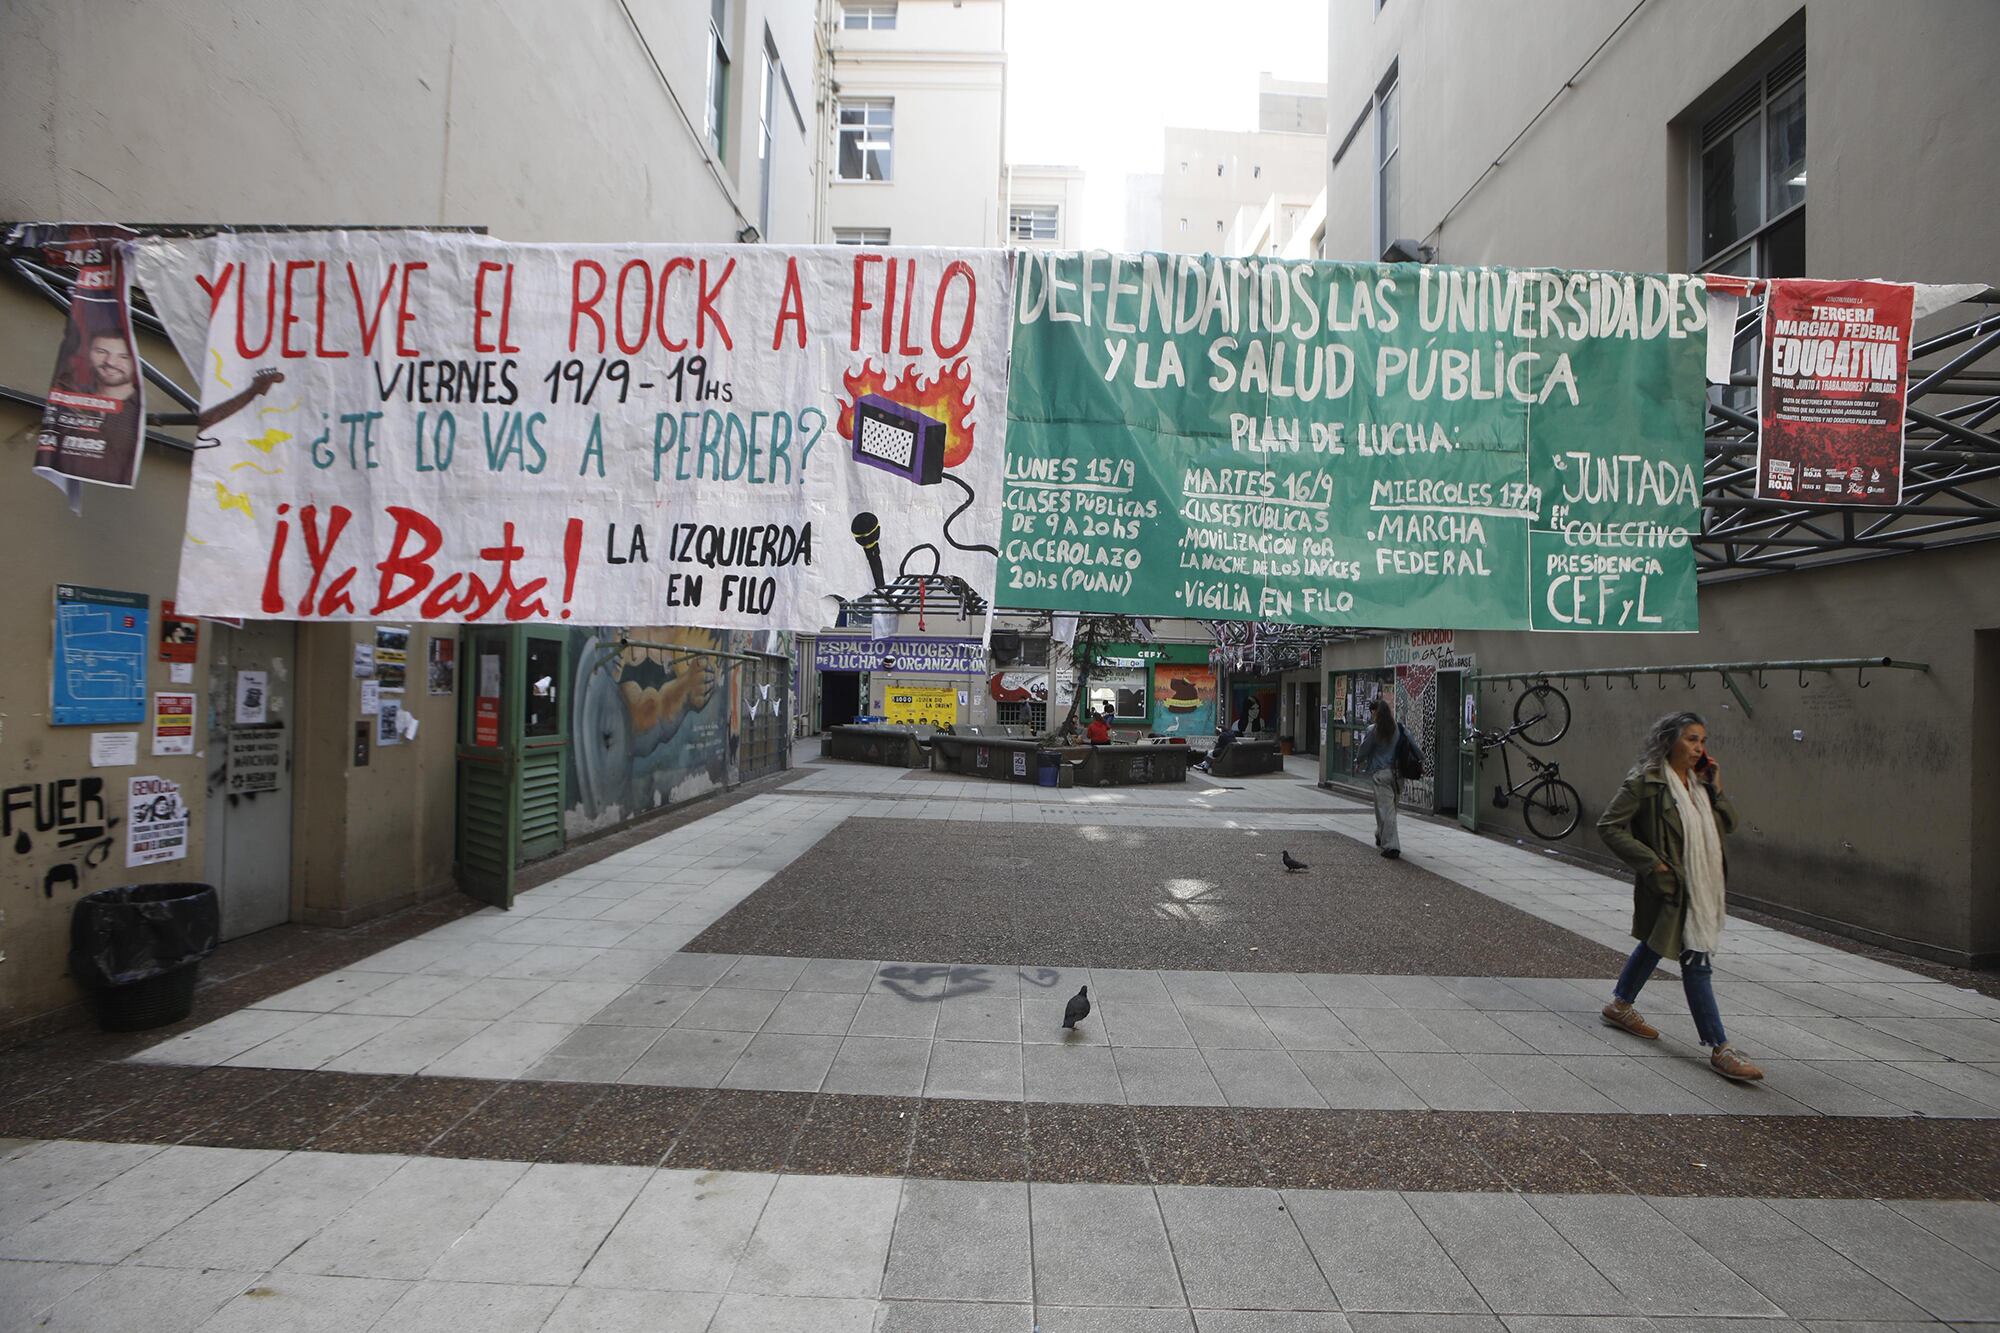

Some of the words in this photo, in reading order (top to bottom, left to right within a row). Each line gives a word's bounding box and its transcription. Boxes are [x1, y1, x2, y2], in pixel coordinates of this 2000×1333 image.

[474, 261, 520, 353] EL
[569, 256, 736, 355] ROCK
[772, 256, 807, 350] A
[850, 254, 976, 359] FILO
[1019, 250, 1320, 340] DEFENDAMOS
[1328, 279, 1399, 333] LAS
[1775, 320, 1839, 337] MARCHA
[1843, 323, 1900, 341] FEDERAL
[1811, 306, 1875, 323] TERCERA
[1104, 338, 1127, 381] Y
[1134, 341, 1185, 388] LA
[1208, 336, 1354, 401] SALUD
[1772, 337, 1898, 381] EDUCATIVA
[375, 360, 519, 405] VIERNES
[1796, 378, 1815, 391] JUNTO
[1821, 380, 1863, 392] TRABAJADORES
[1864, 382, 1868, 392] Y
[310, 410, 384, 470] ¿TE
[416, 410, 456, 472] LO
[483, 410, 547, 474] VAS
[580, 413, 605, 478] A
[653, 407, 827, 484] PERDER?
[1230, 413, 1300, 452] PLAN
[1311, 422, 1345, 455] DE
[1358, 422, 1461, 457] LUCHA:
[1004, 452, 1078, 483] LUNES
[1085, 458, 1135, 487] 15/9
[1183, 467, 1276, 497] MARTES
[1282, 467, 1333, 503] 16/9
[1563, 451, 1700, 508] JUNTADA
[1768, 480, 1793, 491] ROJA
[1007, 489, 1071, 514] CLASES
[1370, 478, 1493, 507] MIERCOLES
[1500, 482, 1542, 513] 17/9
[1552, 505, 1569, 517] EN
[1012, 513, 1036, 534] DE
[1046, 513, 1059, 536] 9
[1064, 516, 1078, 536] A
[1185, 499, 1242, 527] CLASES
[1551, 517, 1566, 530] EL
[607, 523, 649, 565] LA
[670, 521, 812, 568] IZQUIERDA
[1378, 514, 1488, 546] MARCHA
[262, 503, 357, 617] ¡Ya
[369, 506, 583, 622] Basta!
[1006, 538, 1142, 570] CACEROLAZO
[1180, 552, 1199, 569] LA
[1202, 553, 1250, 575] NOCHE
[1253, 559, 1269, 576] DE
[1271, 559, 1301, 576] LOS
[1376, 548, 1491, 576] FEDERAL
[667, 574, 702, 607] EN
[720, 575, 776, 615] FILO
[1061, 566, 1133, 597] (PUAN)
[1259, 585, 1293, 618] EN
[818, 641, 885, 656] ESPACIO
[888, 642, 984, 659] AUTOGESTIVO
[1411, 629, 1454, 648] GENOCIDIO
[1422, 646, 1454, 661] GAZA
[816, 656, 828, 665] DE
[829, 655, 877, 669] LUCHA
[896, 656, 987, 672] ORGANIZACIÓN
